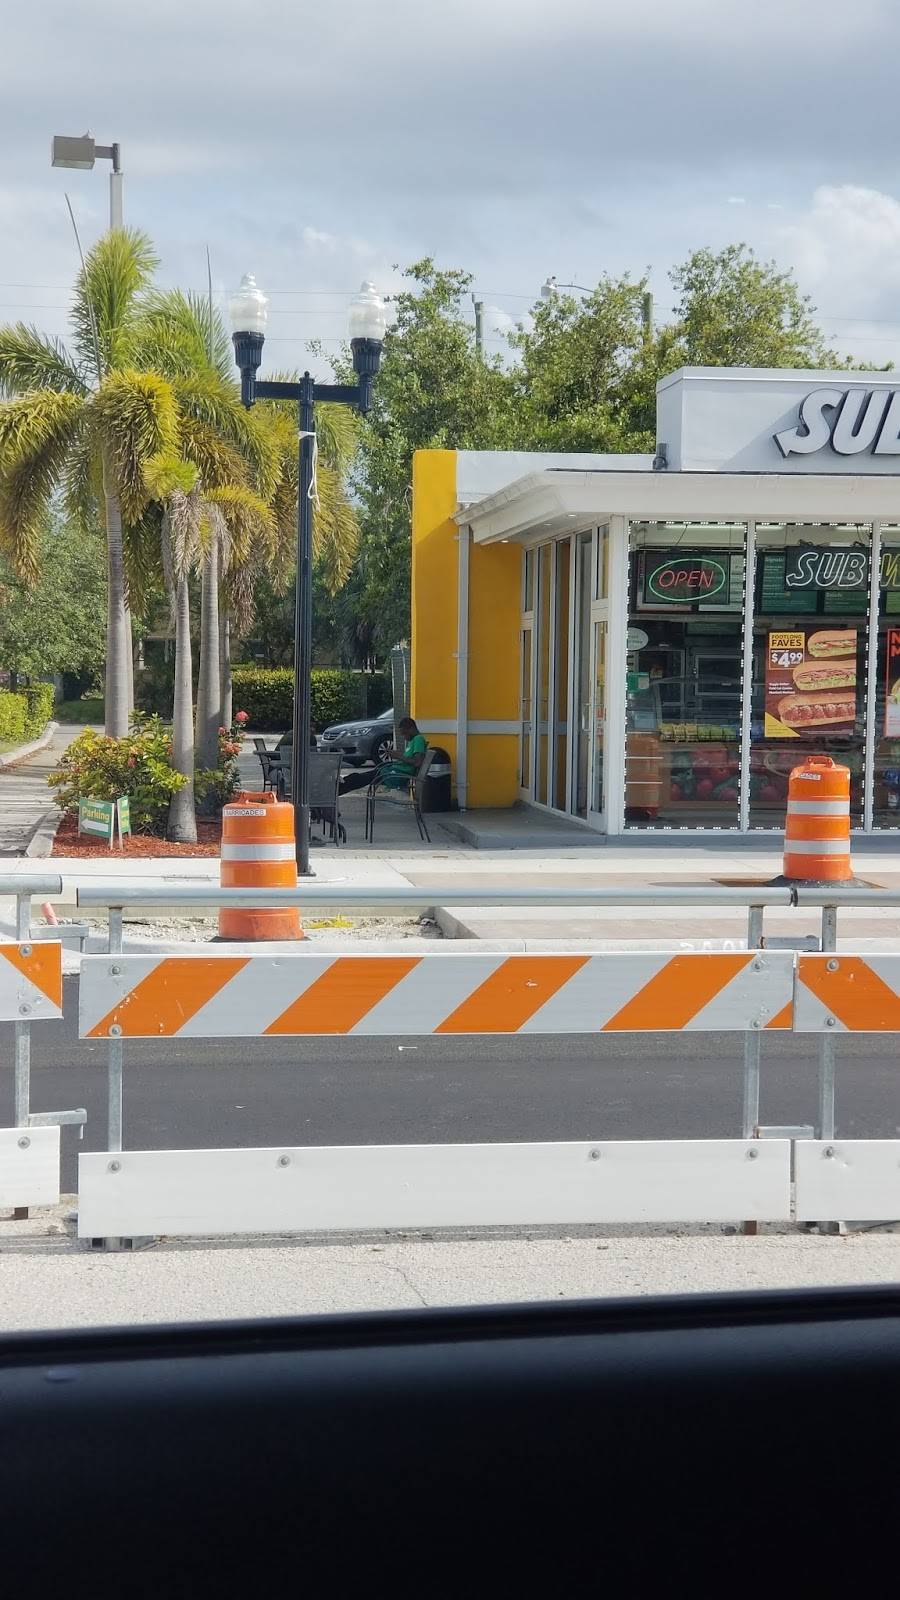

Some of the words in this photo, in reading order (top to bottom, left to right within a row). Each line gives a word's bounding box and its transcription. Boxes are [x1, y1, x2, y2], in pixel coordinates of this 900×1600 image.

[658, 570, 714, 588] OPEN
[771, 639, 802, 647] FAVES
[81, 806, 110, 823] Parking
